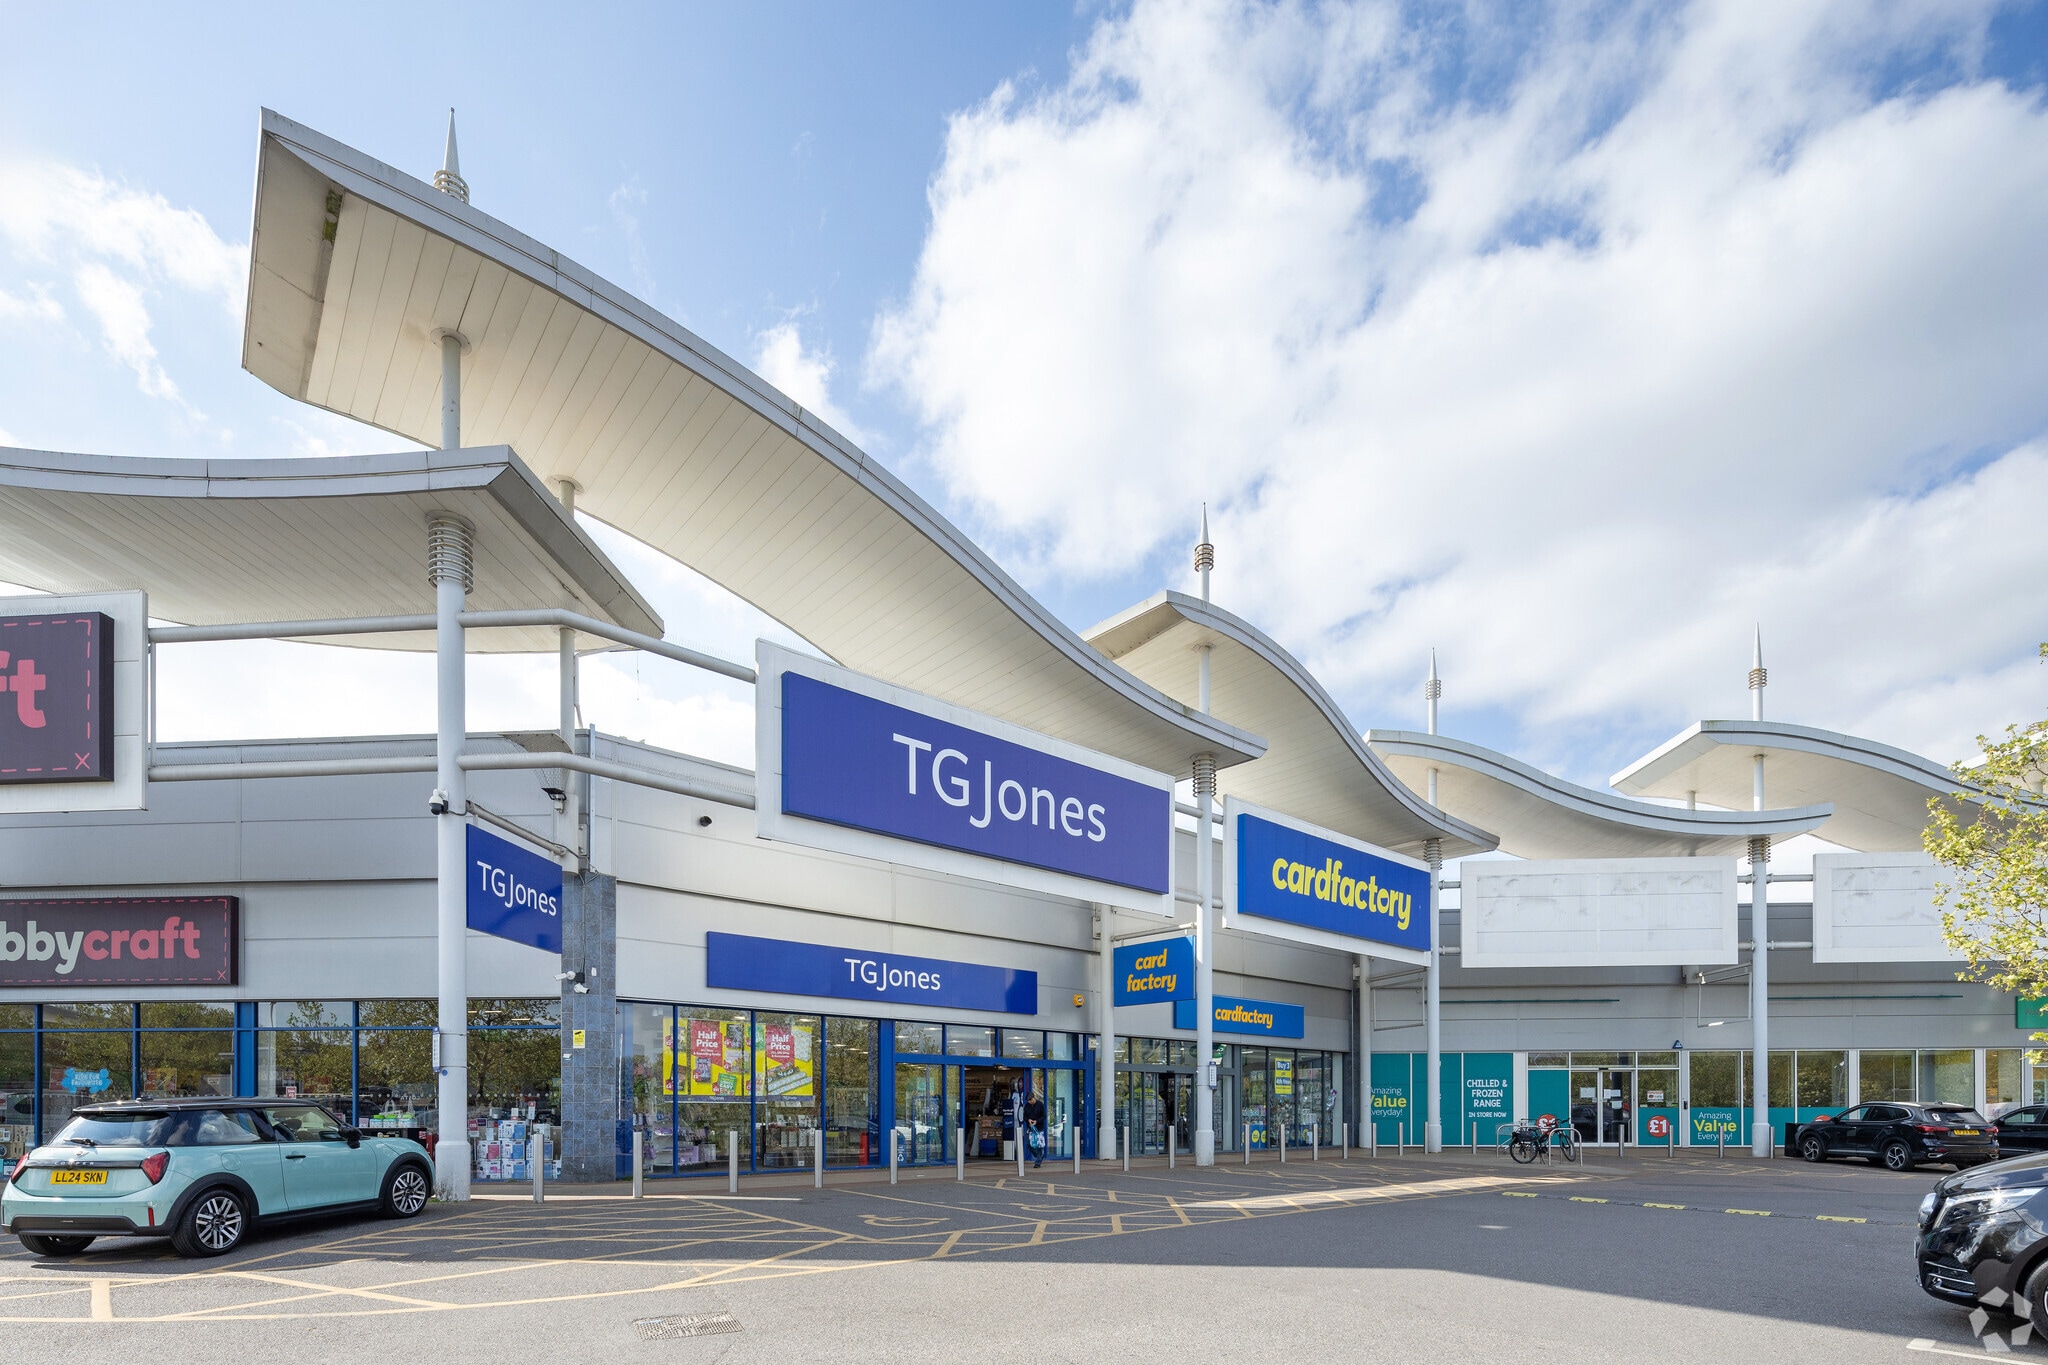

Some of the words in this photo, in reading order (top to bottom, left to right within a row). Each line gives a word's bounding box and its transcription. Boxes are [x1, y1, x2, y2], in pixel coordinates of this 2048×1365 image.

[893, 733, 1106, 842] TGJones
[477, 861, 557, 916] TGJones
[1272, 858, 1411, 930] cardfactory
[1135, 949, 1168, 970] card
[844, 958, 941, 991] TGJones
[1127, 974, 1176, 992] factory
[1215, 1005, 1273, 1029] cardfactory
[698, 1031, 717, 1040] Half
[772, 1034, 790, 1043] Half
[696, 1039, 718, 1048] Price
[770, 1042, 791, 1051] Price
[1277, 1061, 1286, 1070] Buy
[1466, 1079, 1500, 1088] CHILLED
[1471, 1089, 1503, 1097] FROZEN
[1473, 1099, 1501, 1108] RANGE
[1698, 1111, 1732, 1121] Amazing
[1649, 1119, 1667, 1133] £1
[55, 1172, 81, 1183] LL24
[83, 1172, 103, 1183] SKN
